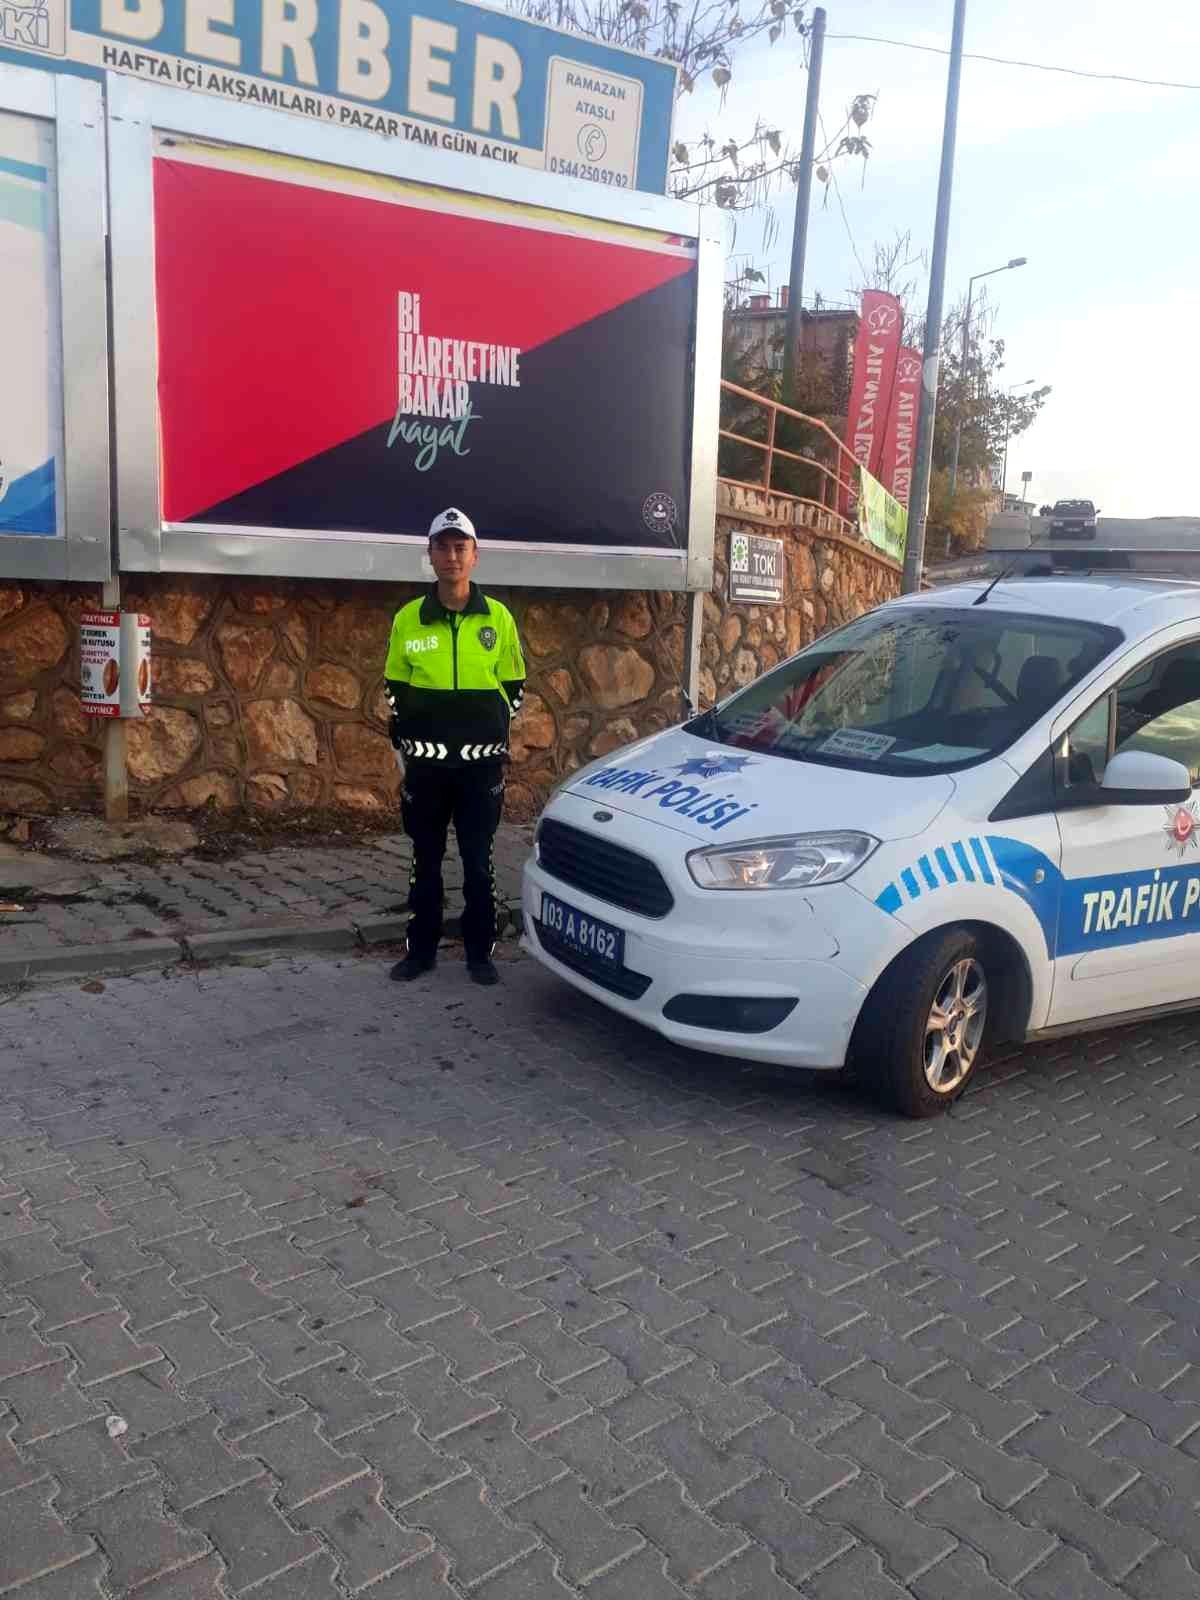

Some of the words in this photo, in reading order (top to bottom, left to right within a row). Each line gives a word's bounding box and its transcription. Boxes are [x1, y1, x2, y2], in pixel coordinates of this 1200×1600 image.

[103, 45, 172, 80] HAFTA
[176, 59, 202, 90] İÇİ
[206, 73, 322, 117] AKŞAMLARI
[340, 106, 398, 137] PAZAR
[402, 122, 438, 147] TAM
[442, 132, 477, 156] GÜN
[566, 71, 626, 100] RAMAZAN
[398, 290, 420, 334] Bİ
[398, 332, 521, 388] HAREKETİNE
[398, 373, 470, 419] BAKAR
[386, 401, 483, 472] hayat
[404, 634, 440, 656] POLİS
[641, 779, 759, 831] POLİSİ
[1082, 869, 1179, 934] TRAFİK
[1182, 877, 1200, 919] P
[548, 902, 563, 931] 03
[566, 912, 576, 940] A
[579, 919, 616, 960] 8162
